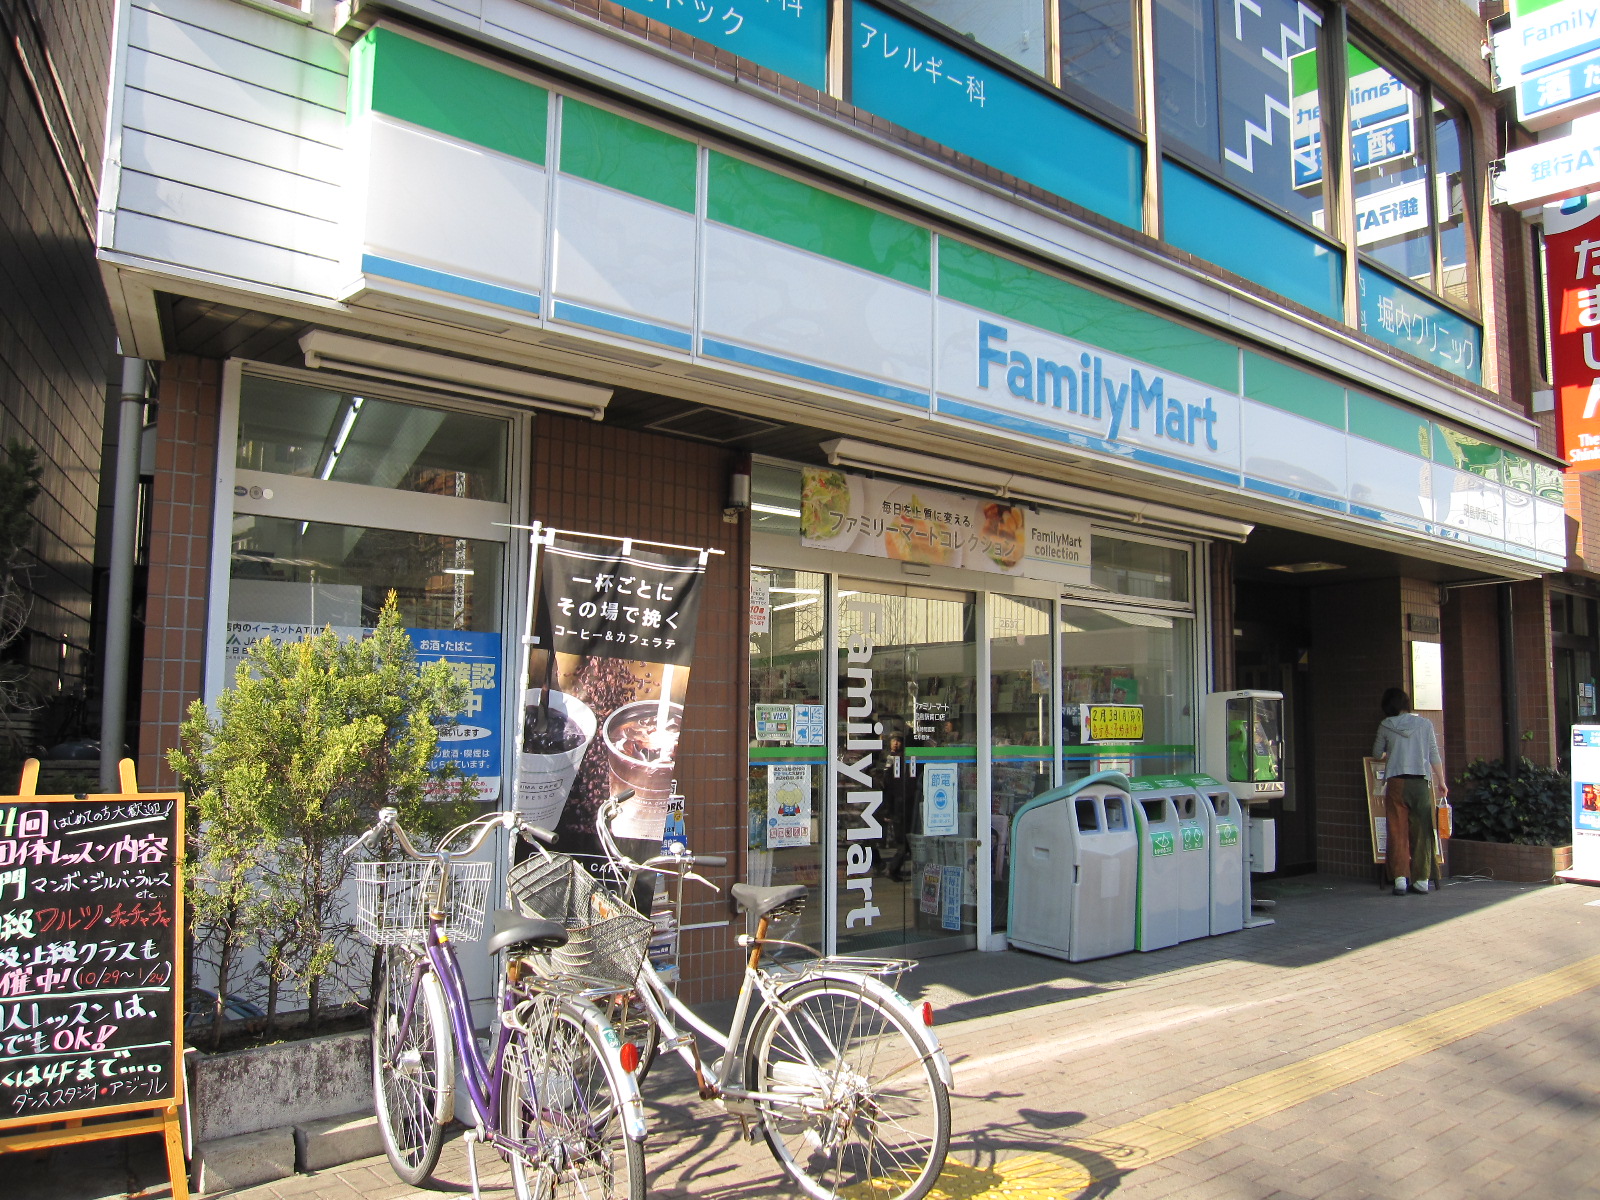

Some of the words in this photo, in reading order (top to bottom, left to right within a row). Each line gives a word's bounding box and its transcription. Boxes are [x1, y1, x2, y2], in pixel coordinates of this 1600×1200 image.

[861, 22, 987, 108] アレルギー科
[1377, 294, 1474, 370] 堀内クリニック
[976, 319, 1218, 451] FamilyMart
[829, 511, 1016, 559] ファミリーマートコレクション
[1031, 527, 1083, 548] FamilyMart
[1034, 544, 1079, 561] collection
[572, 573, 674, 601] 一杯ごとに
[557, 597, 680, 630] その場で挽く
[420, 639, 473, 652] お酒・たばこ
[554, 625, 676, 650] コーヒー&カフェラテ
[773, 712, 788, 720] VISA
[837, 600, 884, 930] FamilyMart
[931, 773, 951, 787] 節電
